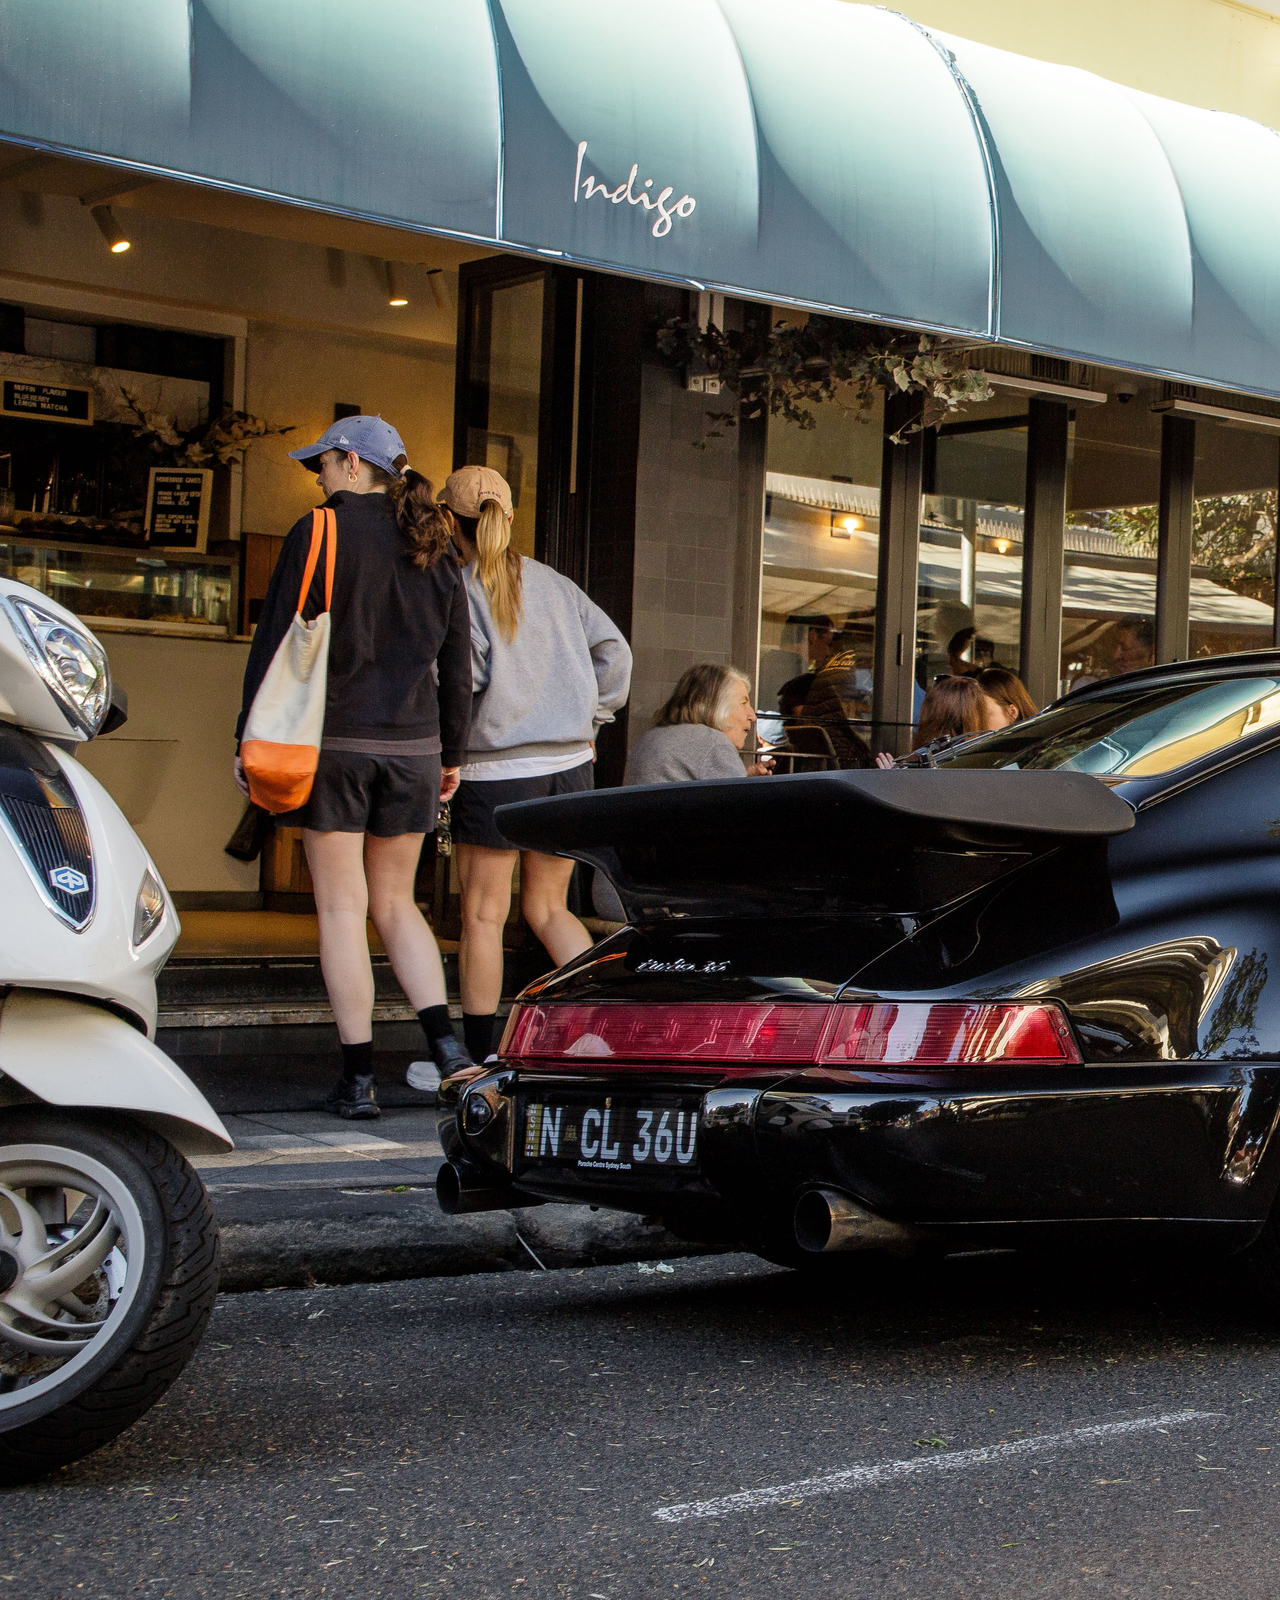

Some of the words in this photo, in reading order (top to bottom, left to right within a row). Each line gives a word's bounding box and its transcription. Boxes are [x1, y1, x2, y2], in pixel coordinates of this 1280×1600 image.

[574, 140, 697, 238] Indigo
[13, 383, 36, 393] MUFFIN
[13, 399, 37, 408] LEMON
[40, 402, 68, 412] MATCHA
[635, 958, 697, 973] turbo
[605, 1162, 619, 1170] Sydney
[619, 1162, 632, 1170] South
